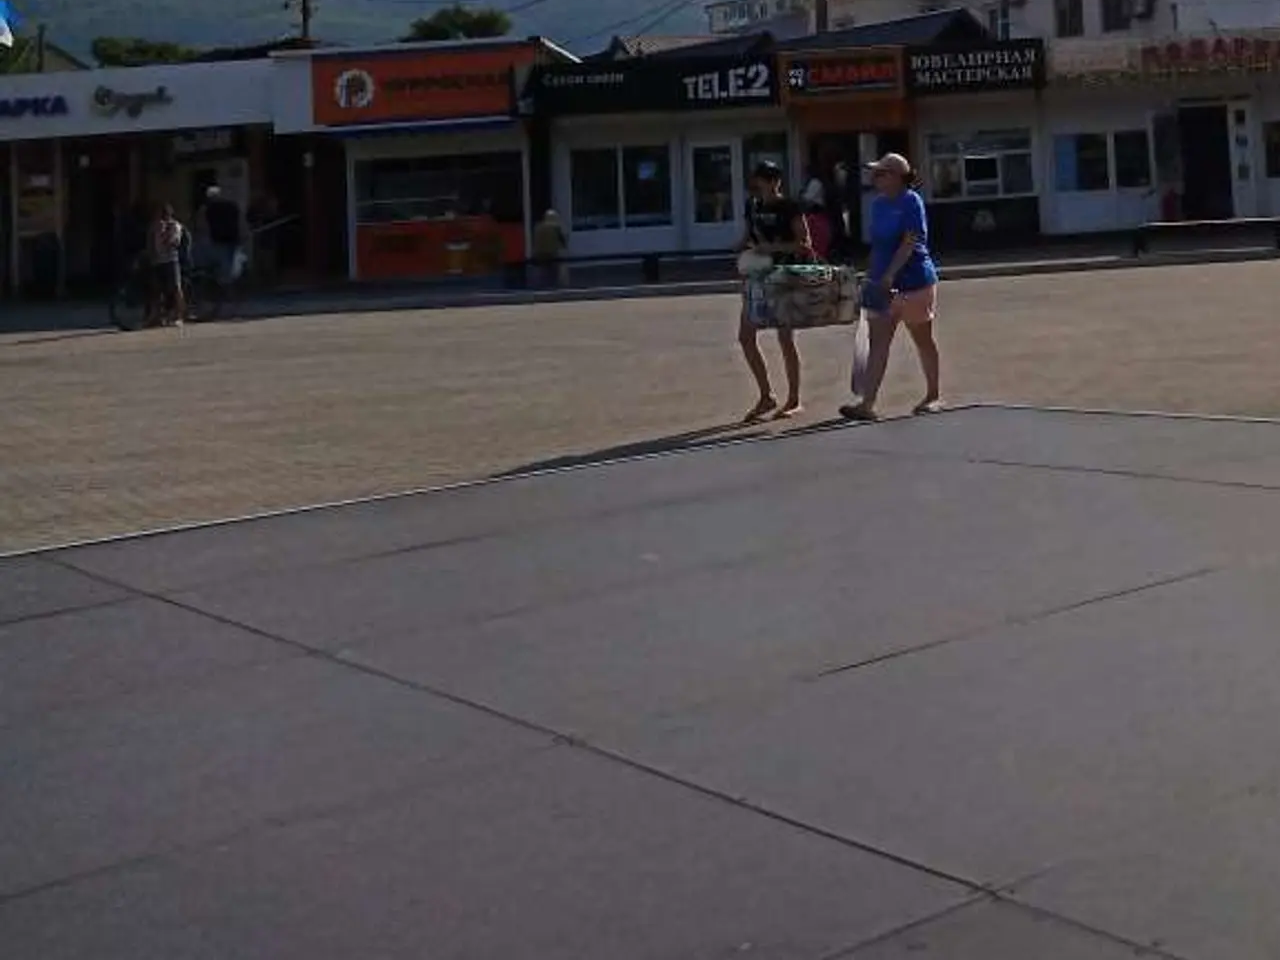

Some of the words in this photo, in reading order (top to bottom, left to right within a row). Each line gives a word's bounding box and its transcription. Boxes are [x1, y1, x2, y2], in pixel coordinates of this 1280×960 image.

[911, 48, 1036, 70] ЮВЕЛИРНАЯ
[682, 63, 769, 100] TELE2
[915, 66, 1034, 85] МАСТЕРСКАЯ
